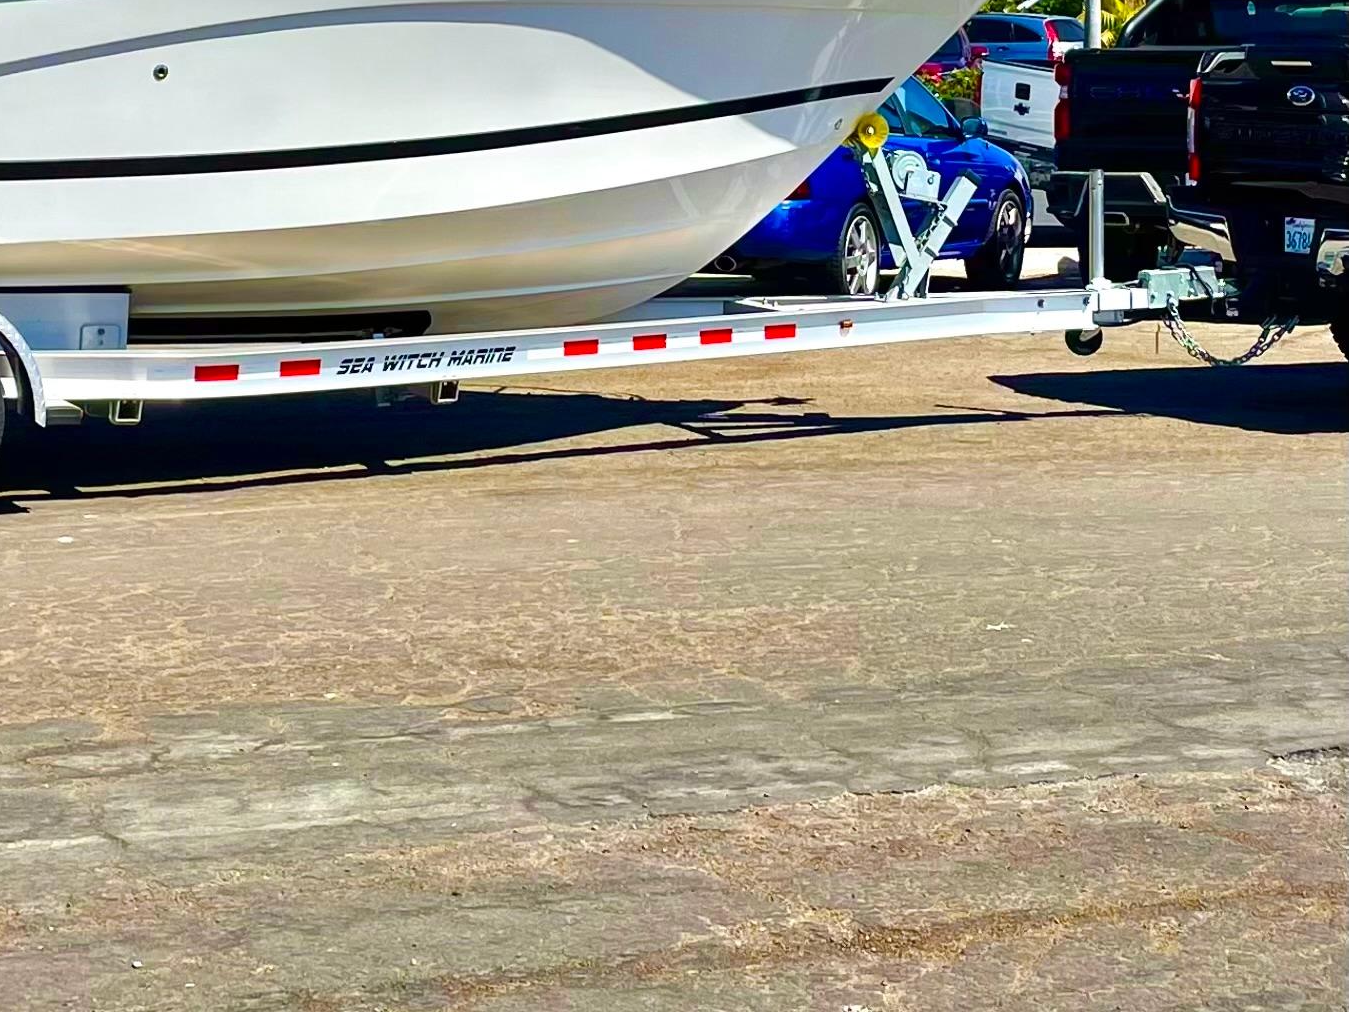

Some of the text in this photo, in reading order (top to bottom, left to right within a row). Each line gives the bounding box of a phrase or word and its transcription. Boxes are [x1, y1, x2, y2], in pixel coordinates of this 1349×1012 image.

[336, 346, 517, 375] SEA WITCH MARINE
